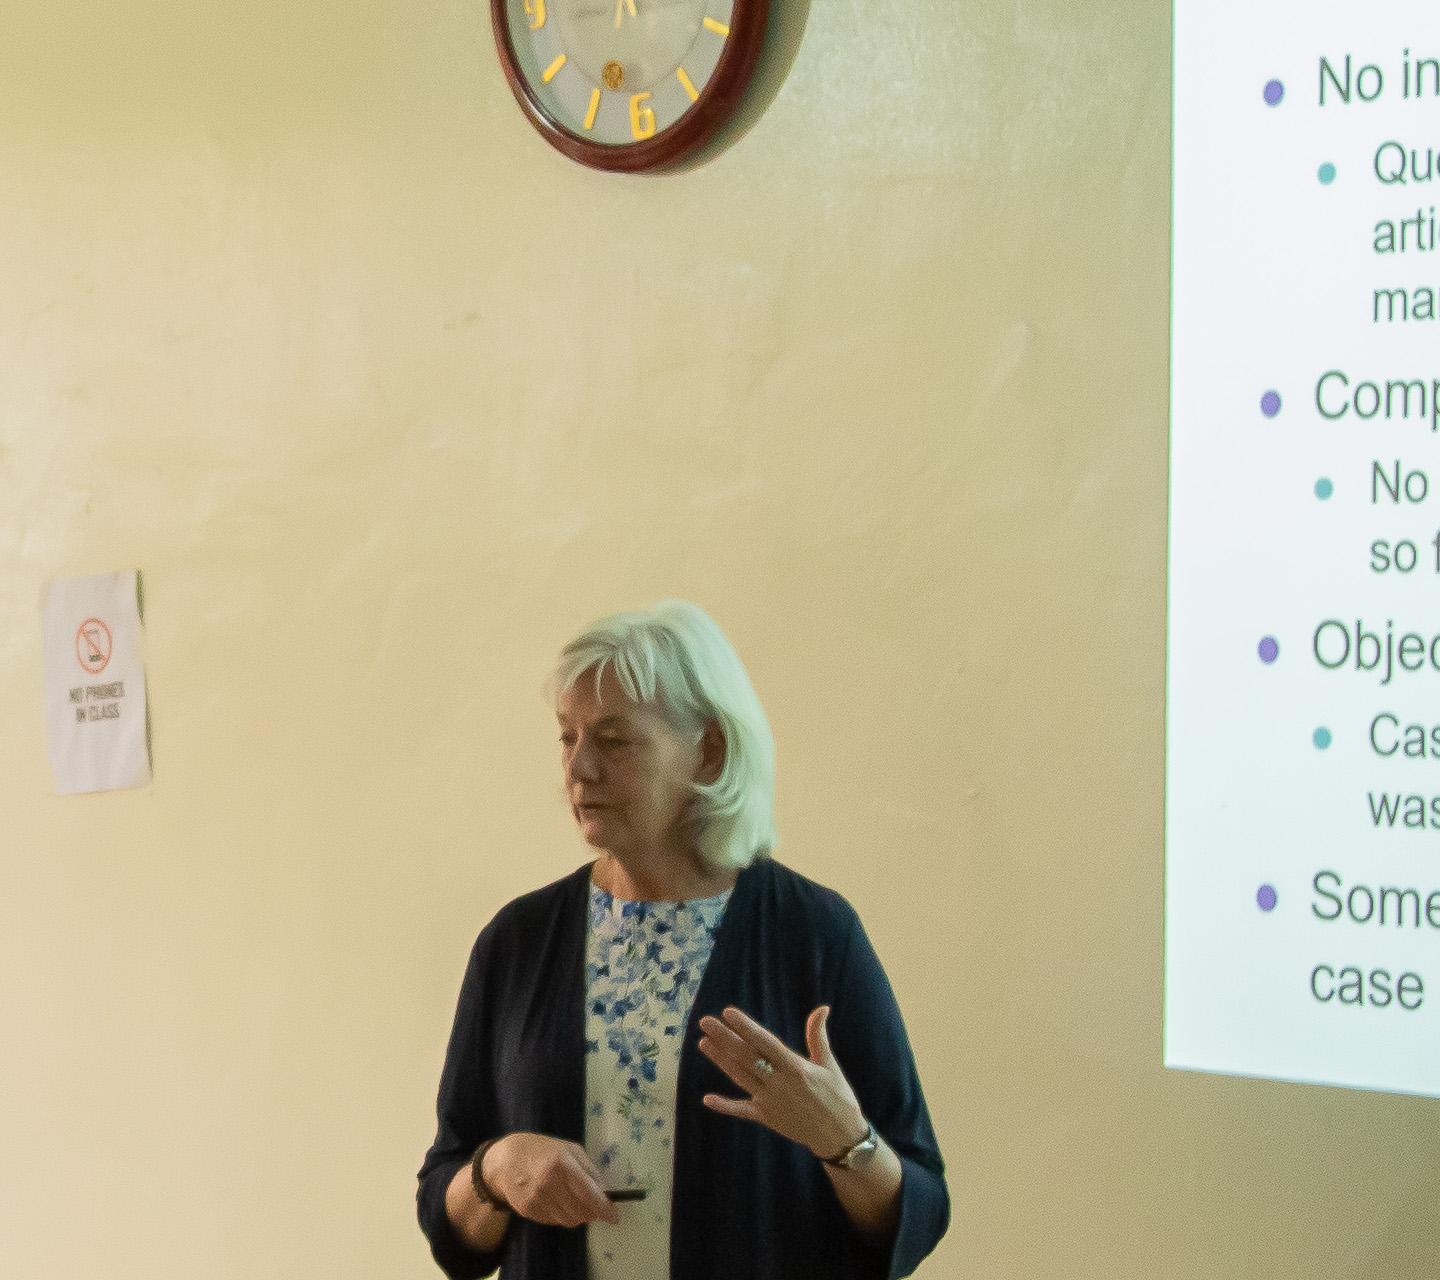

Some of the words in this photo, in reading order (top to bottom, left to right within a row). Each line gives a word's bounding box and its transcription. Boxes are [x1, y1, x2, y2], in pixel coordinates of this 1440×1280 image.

[1319, 55, 1384, 106] No
[629, 92, 656, 140] 6
[1372, 460, 1428, 503] No
[1371, 540, 1417, 573] so
[1311, 965, 1424, 1010] case
